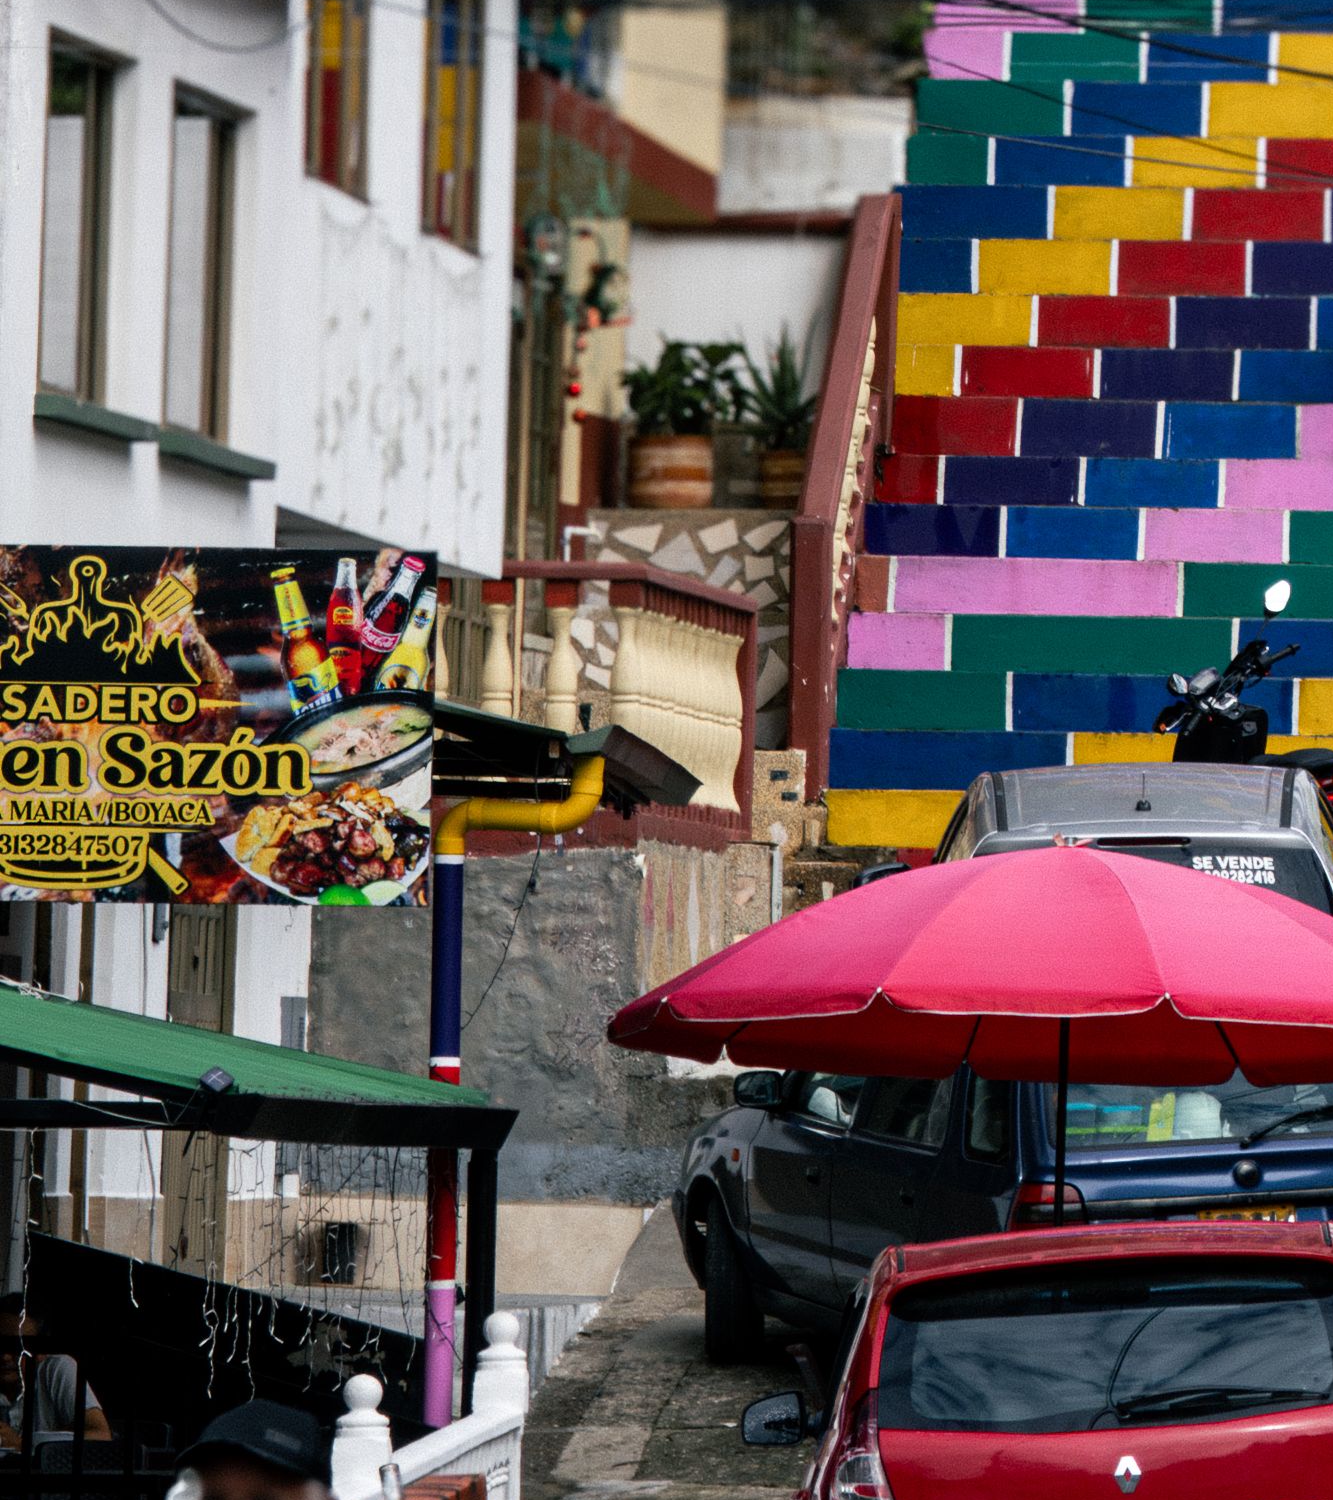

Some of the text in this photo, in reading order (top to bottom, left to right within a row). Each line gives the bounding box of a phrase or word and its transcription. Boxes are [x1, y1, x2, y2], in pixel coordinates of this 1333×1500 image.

[1, 684, 197, 723] SADERO
[103, 732, 306, 791] Sazón
[10, 797, 94, 822] MARÍA
[0, 833, 144, 857] 3132847507
[1192, 855, 1275, 870] SE VENDE
